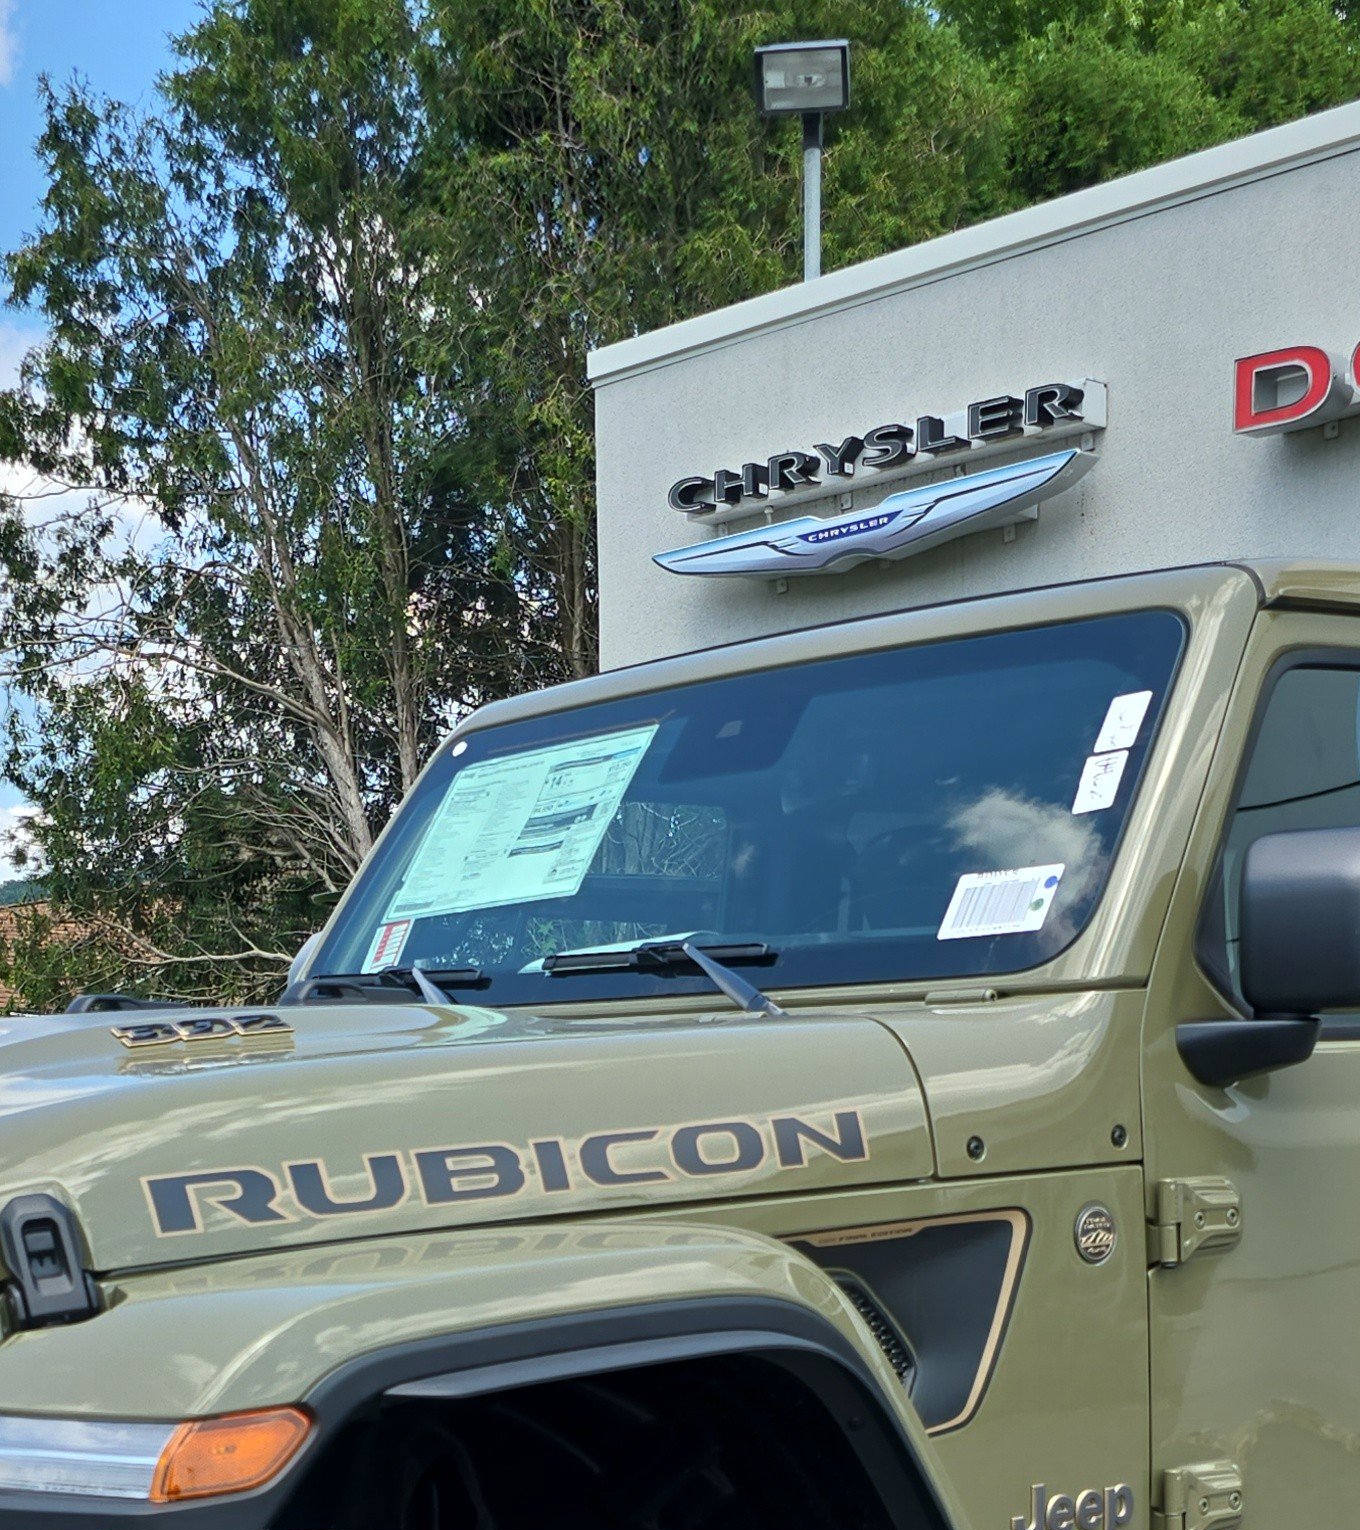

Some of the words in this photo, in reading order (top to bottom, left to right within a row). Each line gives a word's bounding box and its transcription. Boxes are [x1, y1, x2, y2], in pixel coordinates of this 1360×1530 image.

[666, 382, 1086, 515] CHRYSLER
[807, 516, 889, 543] CHRYSLER
[109, 1013, 295, 1048] 392
[140, 1109, 871, 1238] RUBICON
